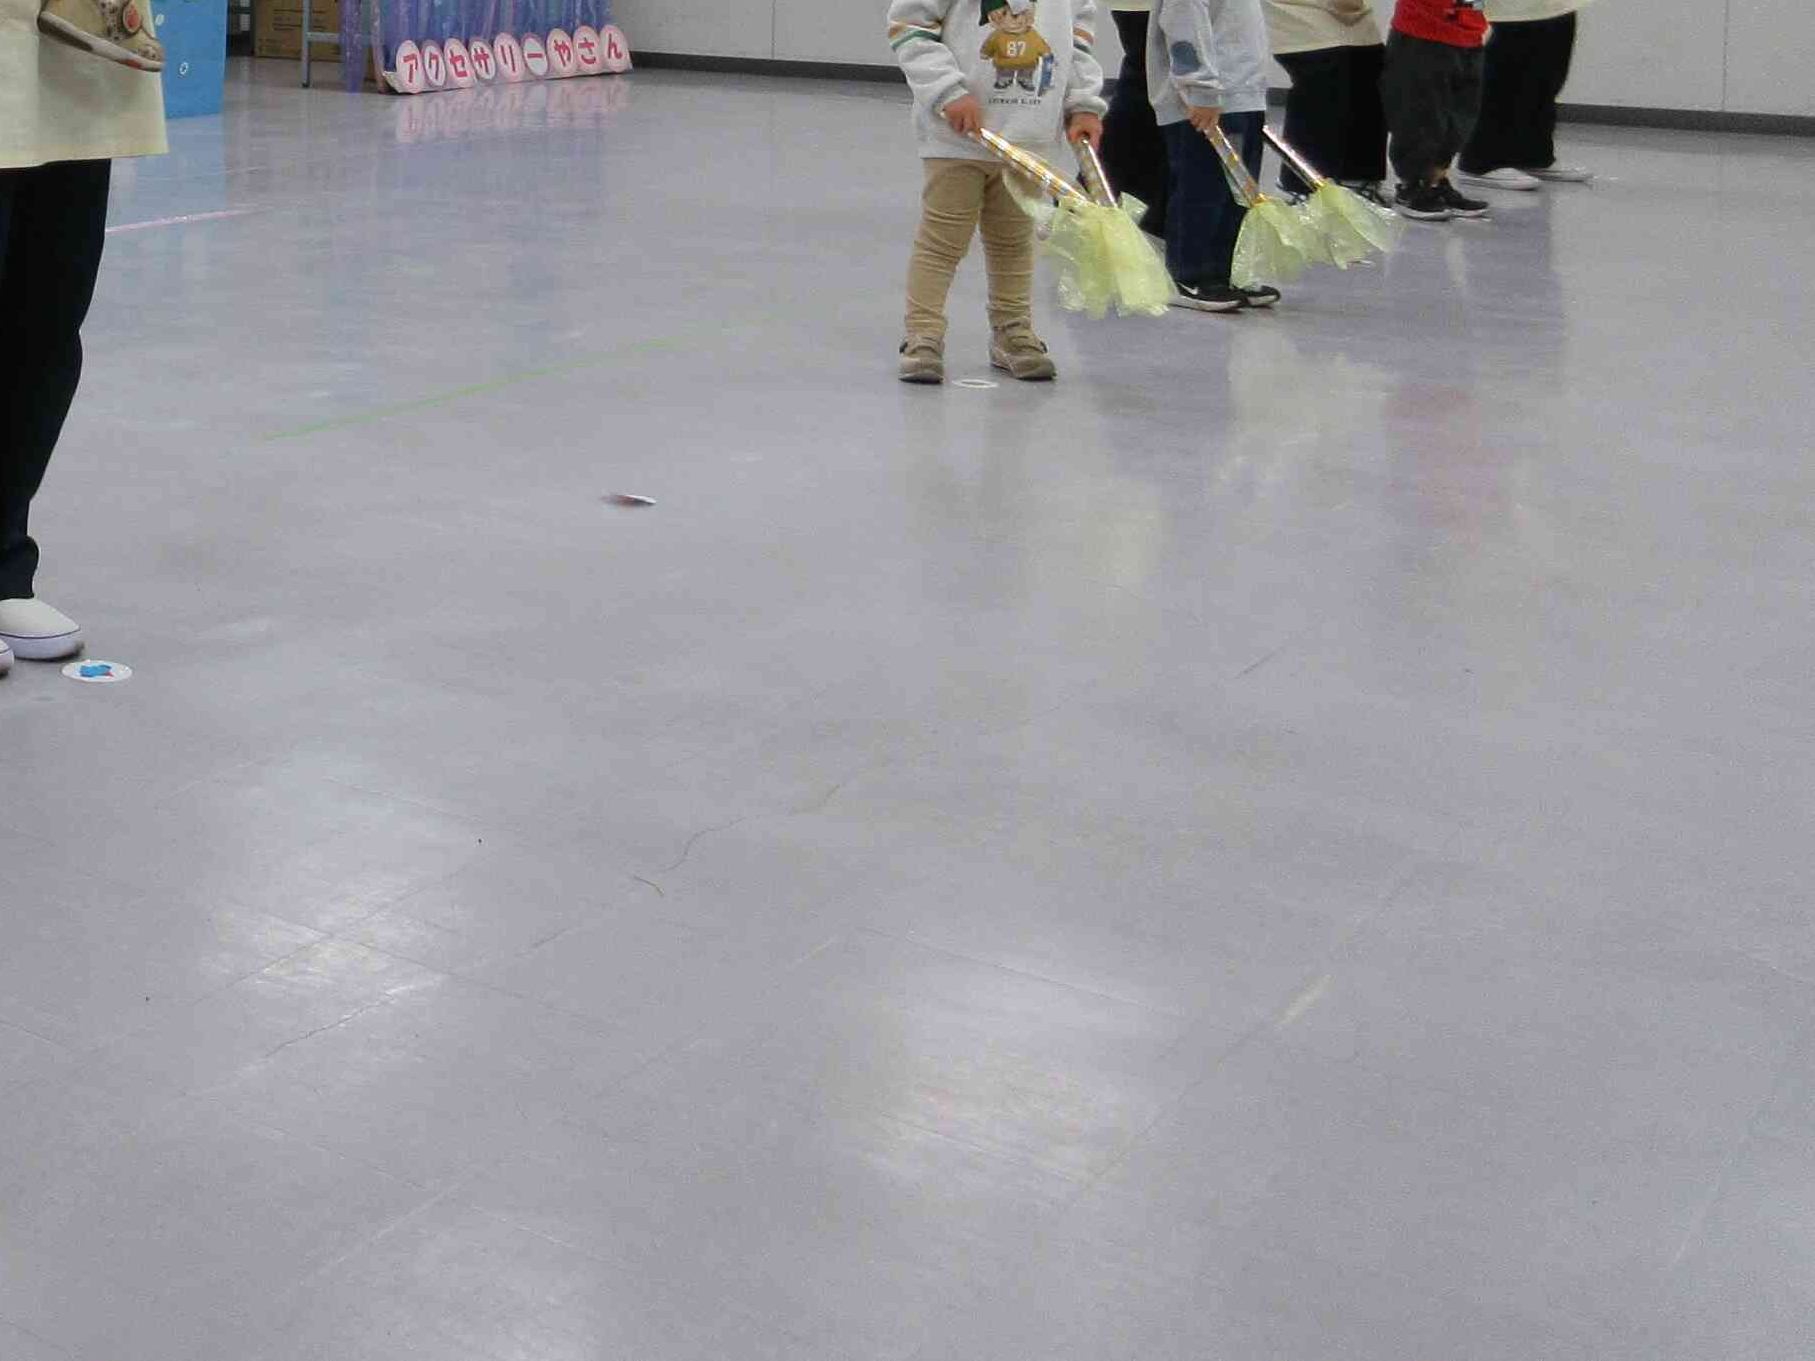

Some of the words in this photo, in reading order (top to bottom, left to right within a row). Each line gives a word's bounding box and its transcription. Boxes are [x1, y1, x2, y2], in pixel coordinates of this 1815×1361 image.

[402, 33, 624, 84] アクセサリーやさん
[1006, 40, 1027, 57] 87
